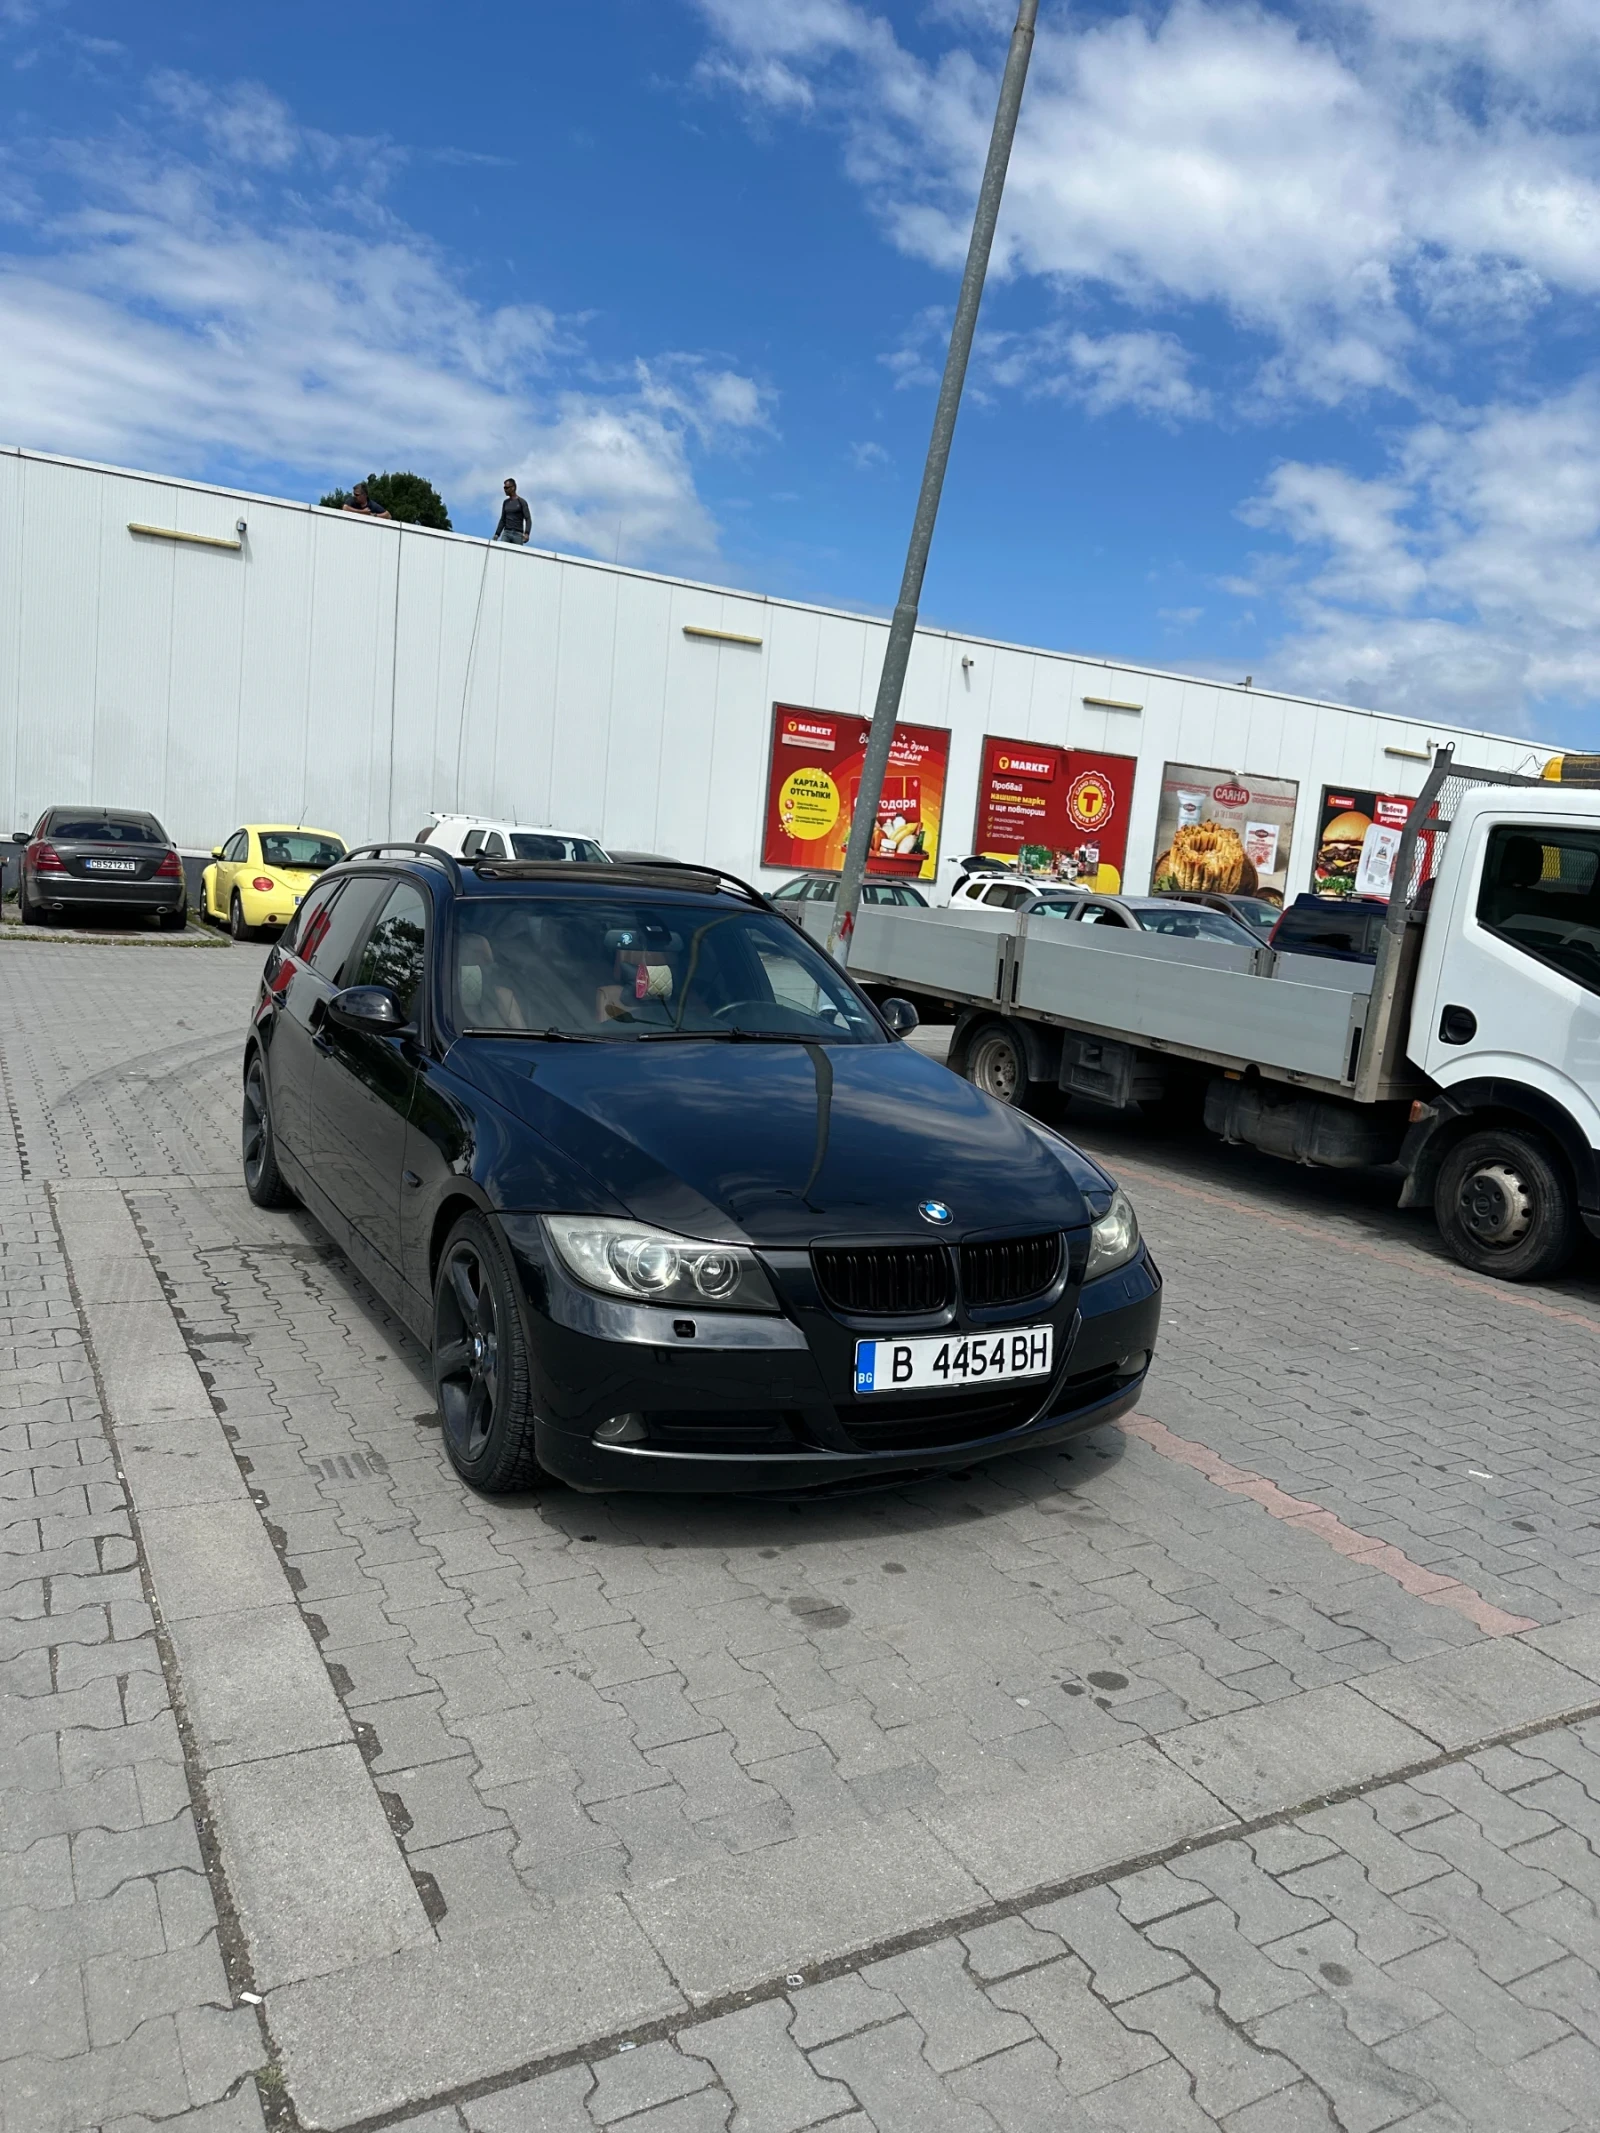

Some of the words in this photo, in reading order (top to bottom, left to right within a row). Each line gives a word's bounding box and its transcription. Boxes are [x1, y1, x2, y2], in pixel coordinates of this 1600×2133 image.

[799, 724, 832, 735] MARKET
[1011, 760, 1049, 773] MARKET
[794, 778, 818, 787] КАРТА
[992, 780, 1023, 792] Пробвай
[790, 788, 831, 799] ОТСТЪПКИ
[991, 793, 1021, 803] нашите
[1022, 797, 1045, 806] марки
[1215, 788, 1247, 802] САЯНА
[1008, 806, 1045, 817] повториш
[91, 860, 101, 868] CB
[103, 861, 122, 869] 5212
[124, 862, 134, 870] XE
[892, 1346, 913, 1383] B
[933, 1338, 1005, 1379] 4454
[1011, 1333, 1048, 1372] BH
[858, 1372, 873, 1384] BG
